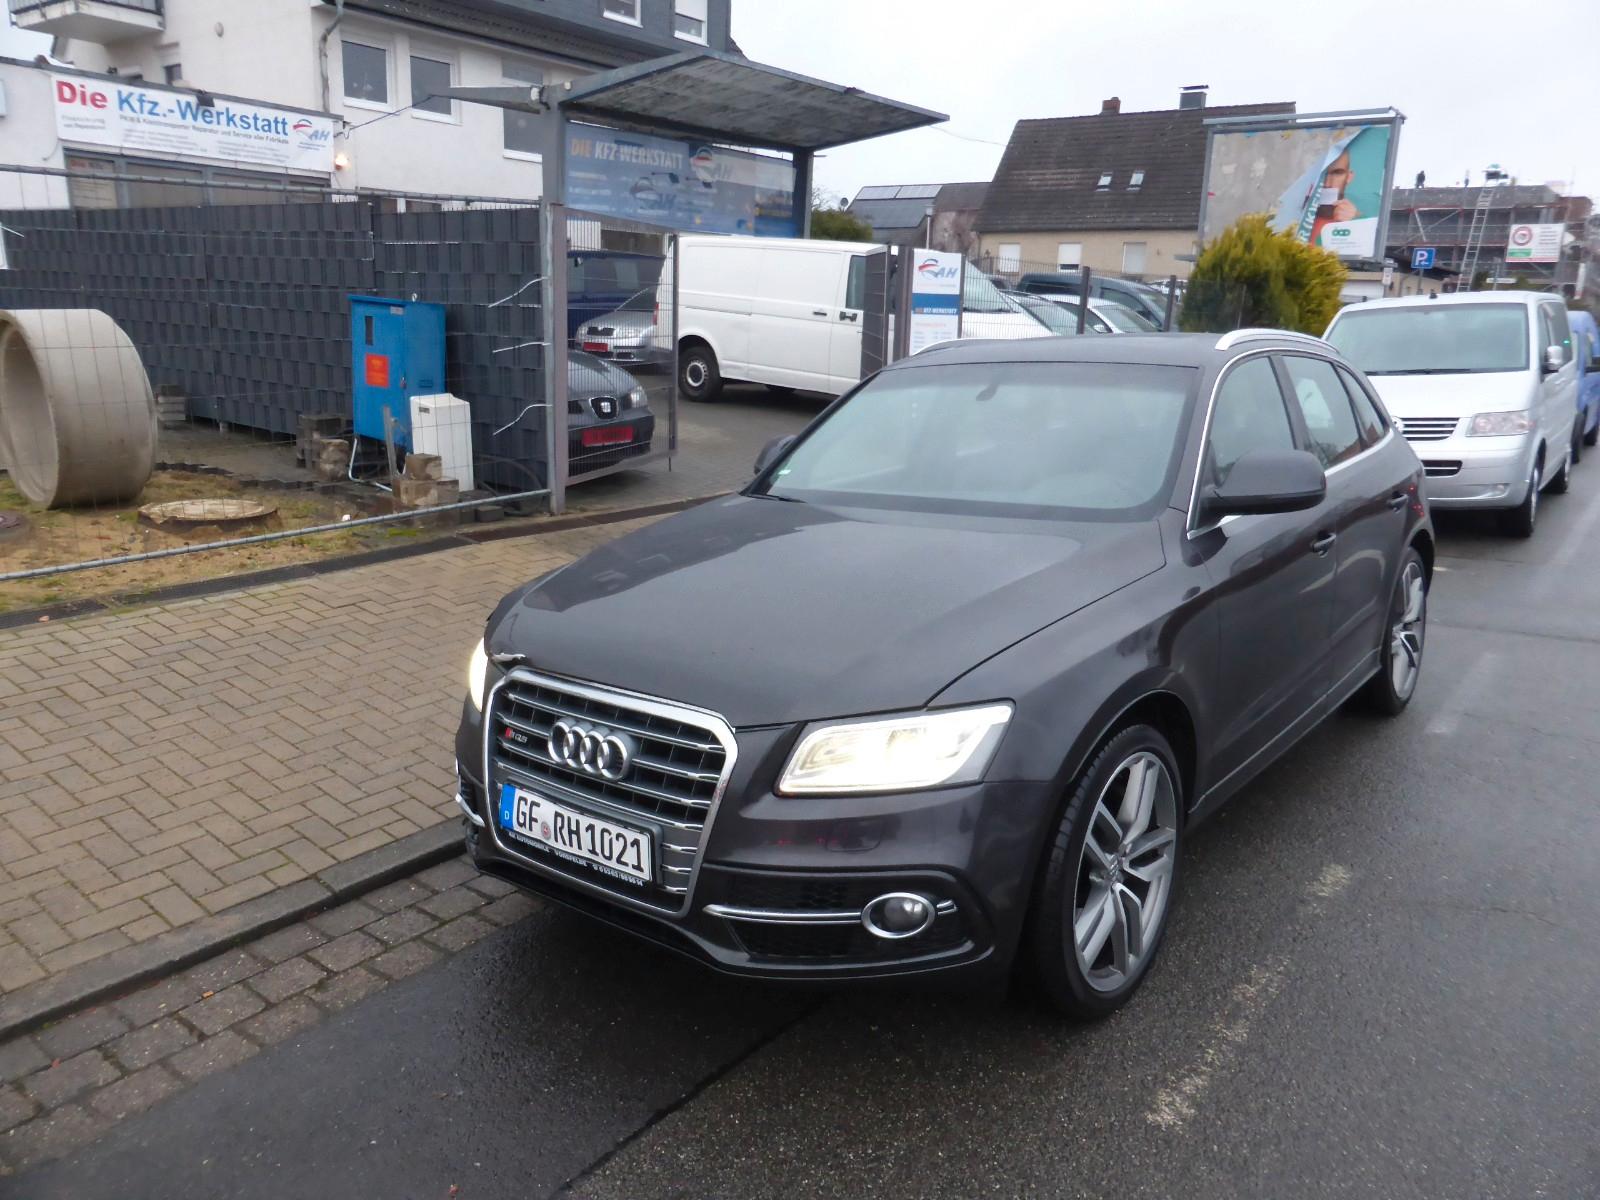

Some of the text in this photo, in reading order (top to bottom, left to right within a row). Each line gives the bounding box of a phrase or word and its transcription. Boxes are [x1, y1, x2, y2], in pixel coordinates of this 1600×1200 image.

[57, 80, 288, 136] Die Kfz.-Werkstatt
[310, 130, 330, 141] AH
[570, 138, 593, 158] DIE
[1416, 251, 1428, 266] P
[937, 267, 958, 279] AH
[504, 810, 510, 820] D
[516, 796, 541, 832] GF
